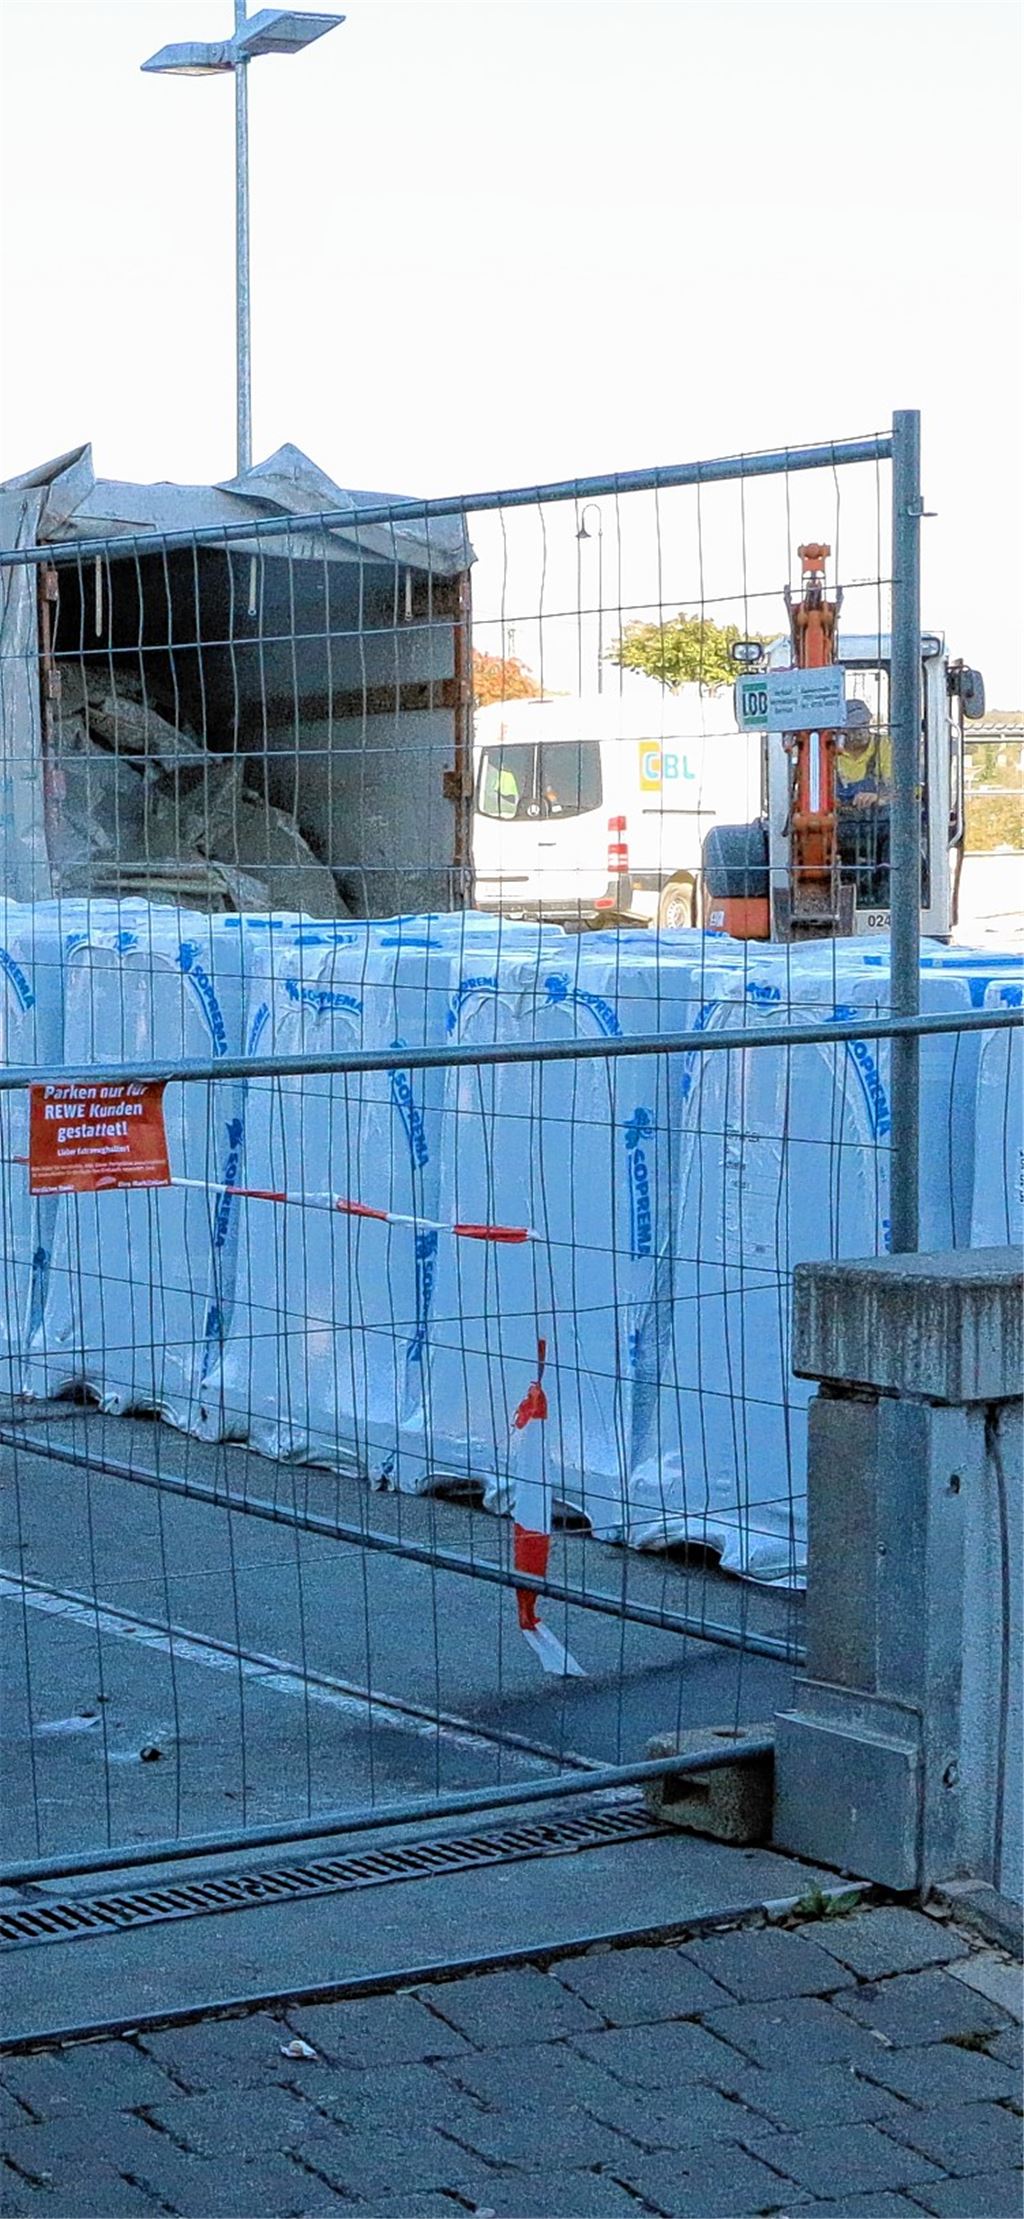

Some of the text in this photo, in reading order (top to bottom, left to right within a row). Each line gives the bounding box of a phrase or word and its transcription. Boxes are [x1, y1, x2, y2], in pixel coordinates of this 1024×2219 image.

[645, 753, 696, 780] CBL
[44, 1085, 97, 1099] Parken
[100, 1087, 125, 1098] nur
[850, 1040, 891, 1137] OPREMA
[44, 1101, 143, 1120] REWE Kunden
[57, 1121, 128, 1143] gestattet!
[634, 1148, 651, 1260] SOPREMA
